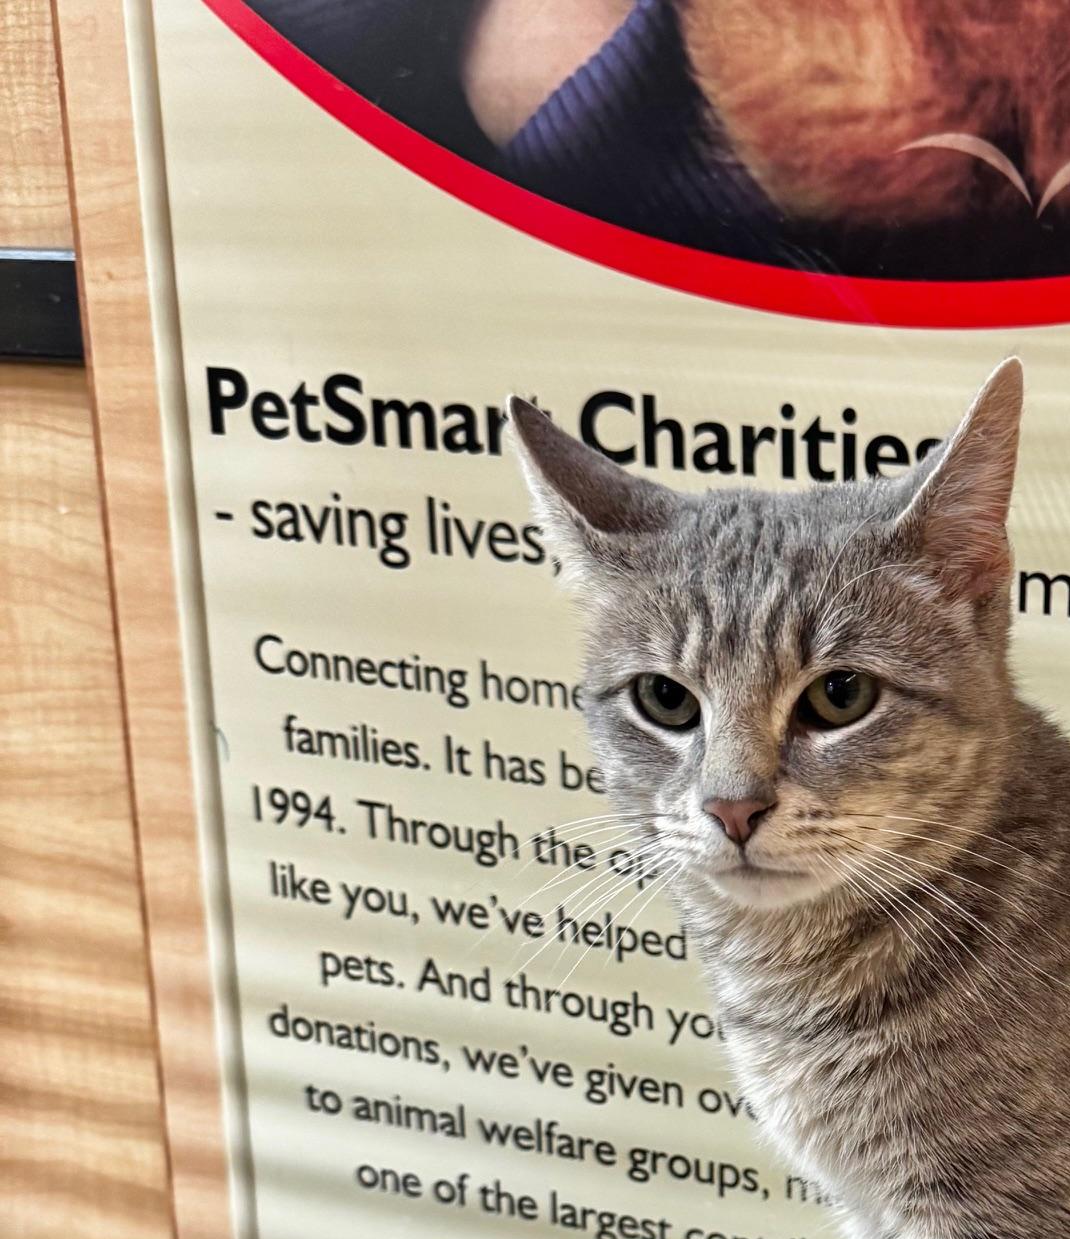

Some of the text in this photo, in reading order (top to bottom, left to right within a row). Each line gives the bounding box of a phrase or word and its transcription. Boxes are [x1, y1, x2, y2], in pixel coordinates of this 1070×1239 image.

[206, 366, 552, 456] PetSmar
[251, 492, 411, 570] saving
[254, 634, 471, 710] Connecting
[283, 715, 607, 795] families. It has be
[252, 783, 348, 835] 1994.
[357, 798, 519, 868] Through
[532, 827, 597, 872] the
[268, 860, 688, 964] like you, we've helped
[319, 948, 405, 990] pets.
[417, 958, 492, 1003] And
[504, 973, 654, 1037] through
[268, 1003, 452, 1075] donations,
[461, 1040, 574, 1090] we've
[585, 1064, 684, 1105] given
[304, 1082, 343, 1118] to
[352, 1095, 466, 1140] animal
[476, 1116, 617, 1168] welfare
[629, 1147, 770, 1200] groups,
[356, 1162, 423, 1198] one
[433, 1172, 468, 1208] of
[479, 1180, 539, 1222] the
